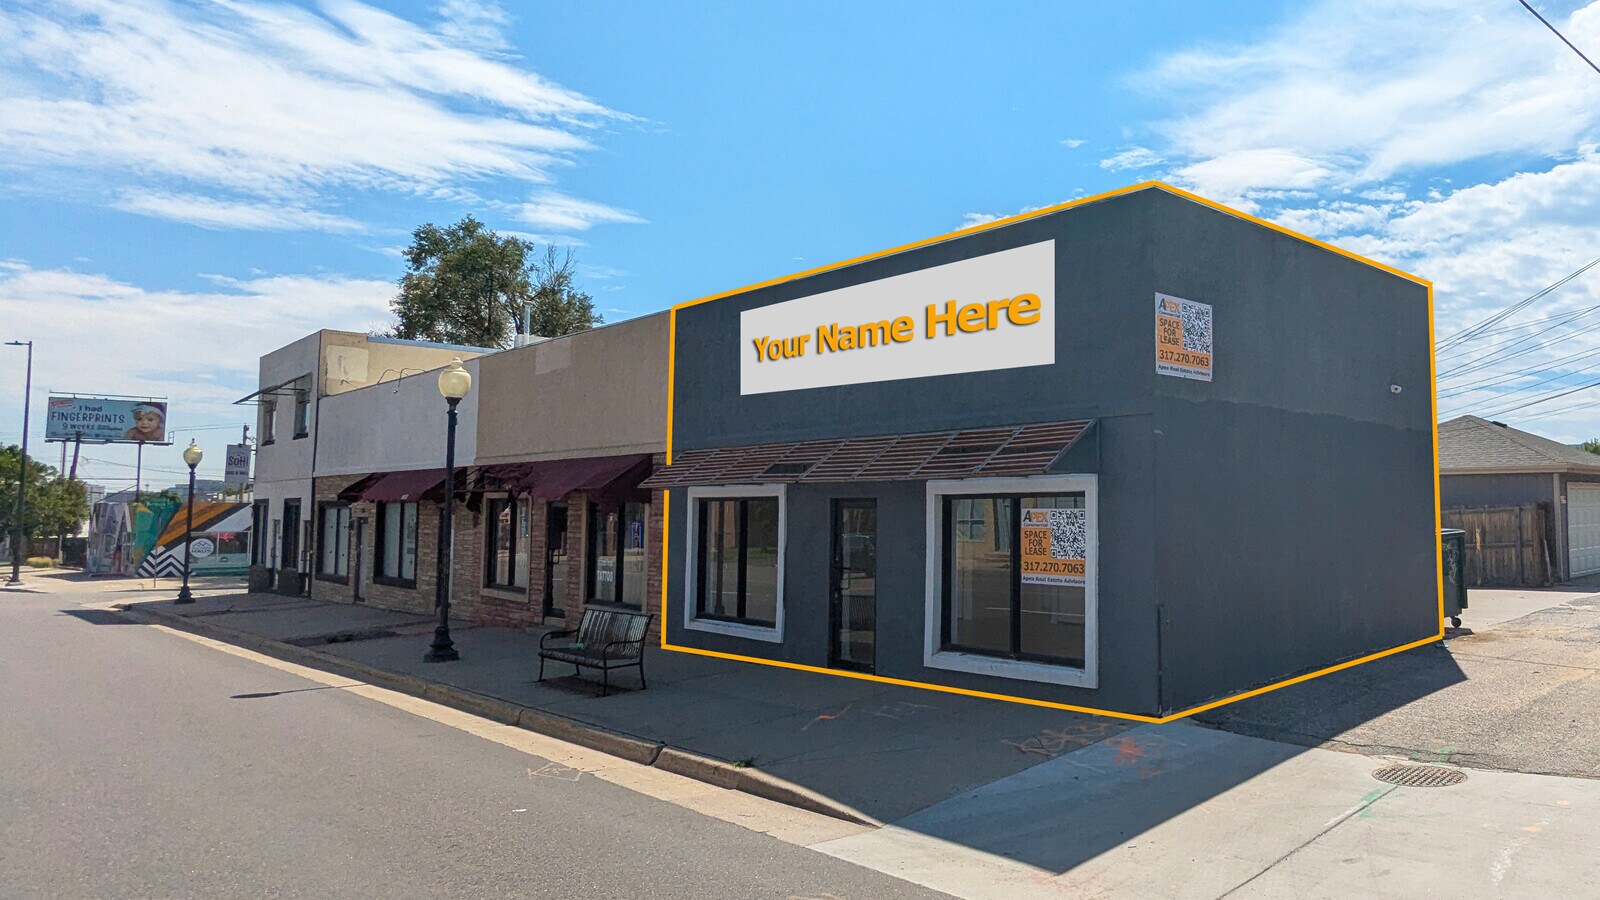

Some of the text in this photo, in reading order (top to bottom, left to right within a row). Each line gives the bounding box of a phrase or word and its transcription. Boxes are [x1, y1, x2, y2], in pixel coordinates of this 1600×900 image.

[1159, 318, 1180, 330] SPACE
[1163, 327, 1177, 337] FOR
[1160, 335, 1180, 347] LEASE
[1159, 349, 1209, 367] 317.270.7063
[51, 411, 125, 424] FINGERPRINTS
[62, 422, 68, 430] 9
[69, 423, 96, 431] weeks
[1024, 530, 1047, 539] SPACE
[1028, 539, 1043, 547] FOR
[1024, 547, 1047, 556] LEASE
[1023, 561, 1085, 574] 317.270.7063
